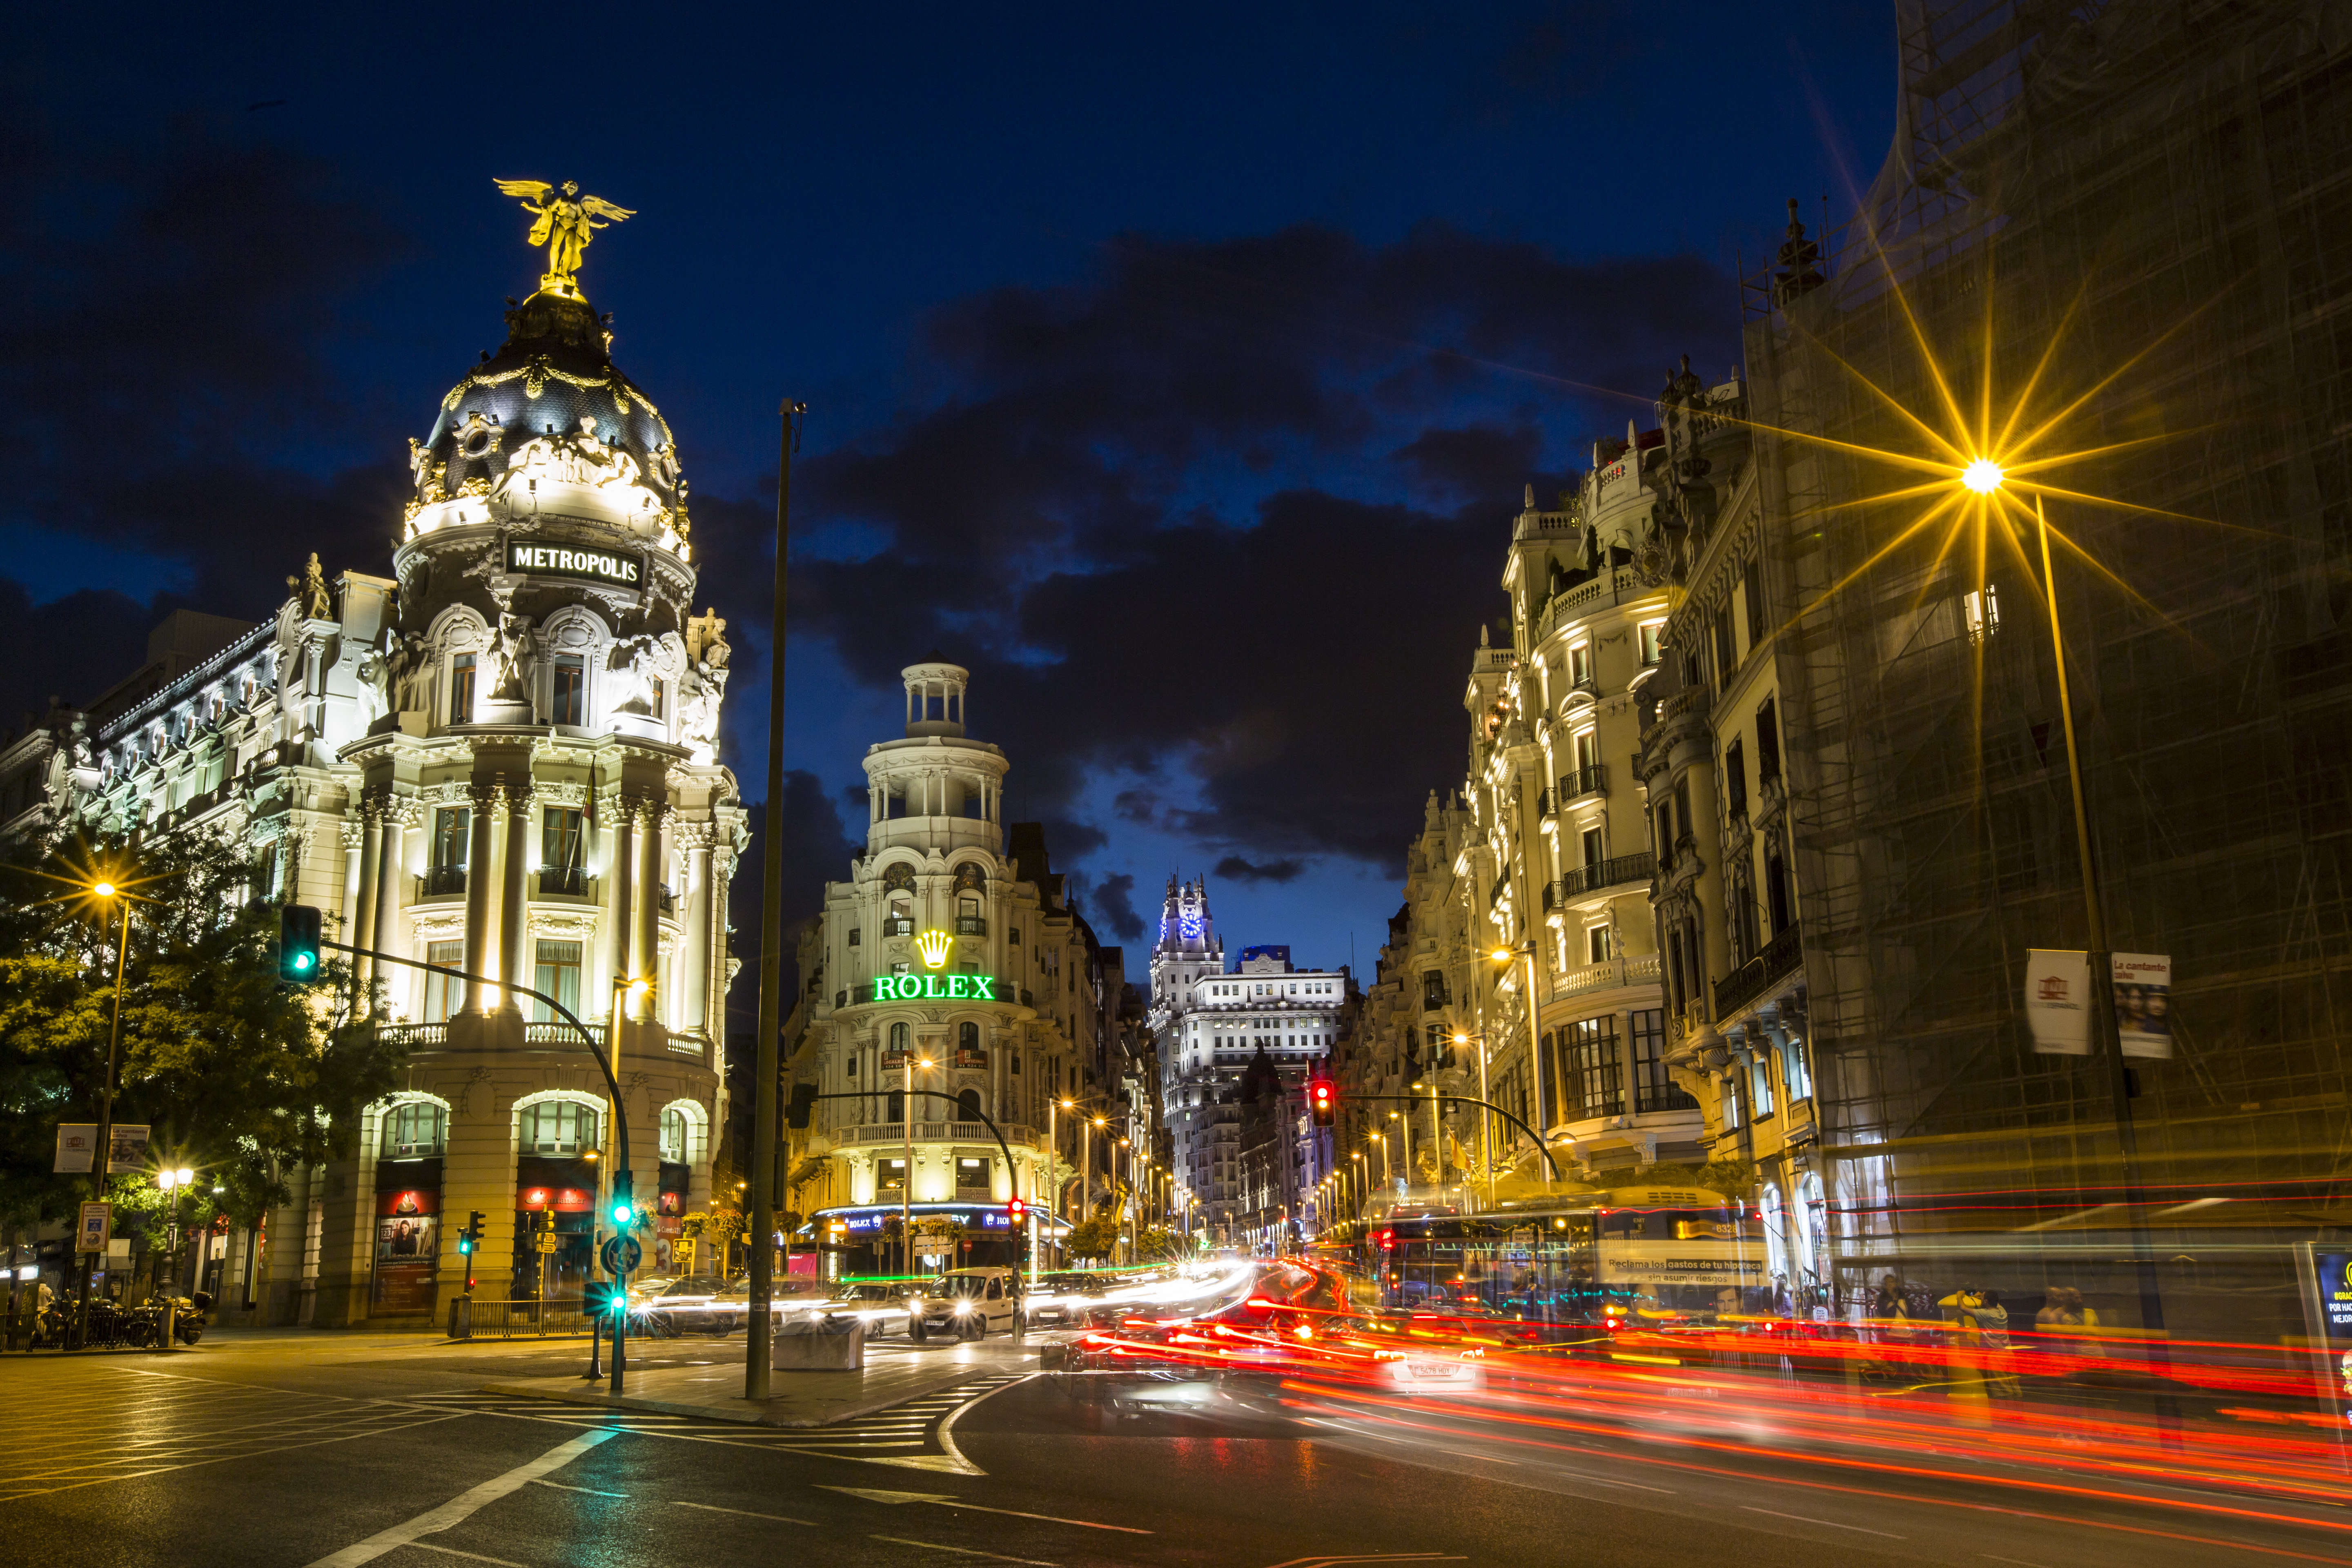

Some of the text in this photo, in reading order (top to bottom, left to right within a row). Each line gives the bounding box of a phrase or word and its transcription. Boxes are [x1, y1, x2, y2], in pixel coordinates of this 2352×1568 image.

[515, 548, 637, 581] METROPOLIS
[2114, 960, 2166, 972] La cantante
[874, 975, 995, 1000] ROLEX
[541, 1195, 586, 1205] Santander
[1716, 1224, 1737, 1233] 8328
[1609, 1259, 1649, 1268] Reclama
[1668, 1261, 1697, 1270] gastos
[1700, 1261, 1711, 1269] de
[1724, 1261, 1761, 1271] hipoteca
[1648, 1273, 1727, 1284] sin asumir riesgos
[2334, 1292, 2352, 1300] #GRAC
[2329, 1303, 2352, 1312] POR HAC
